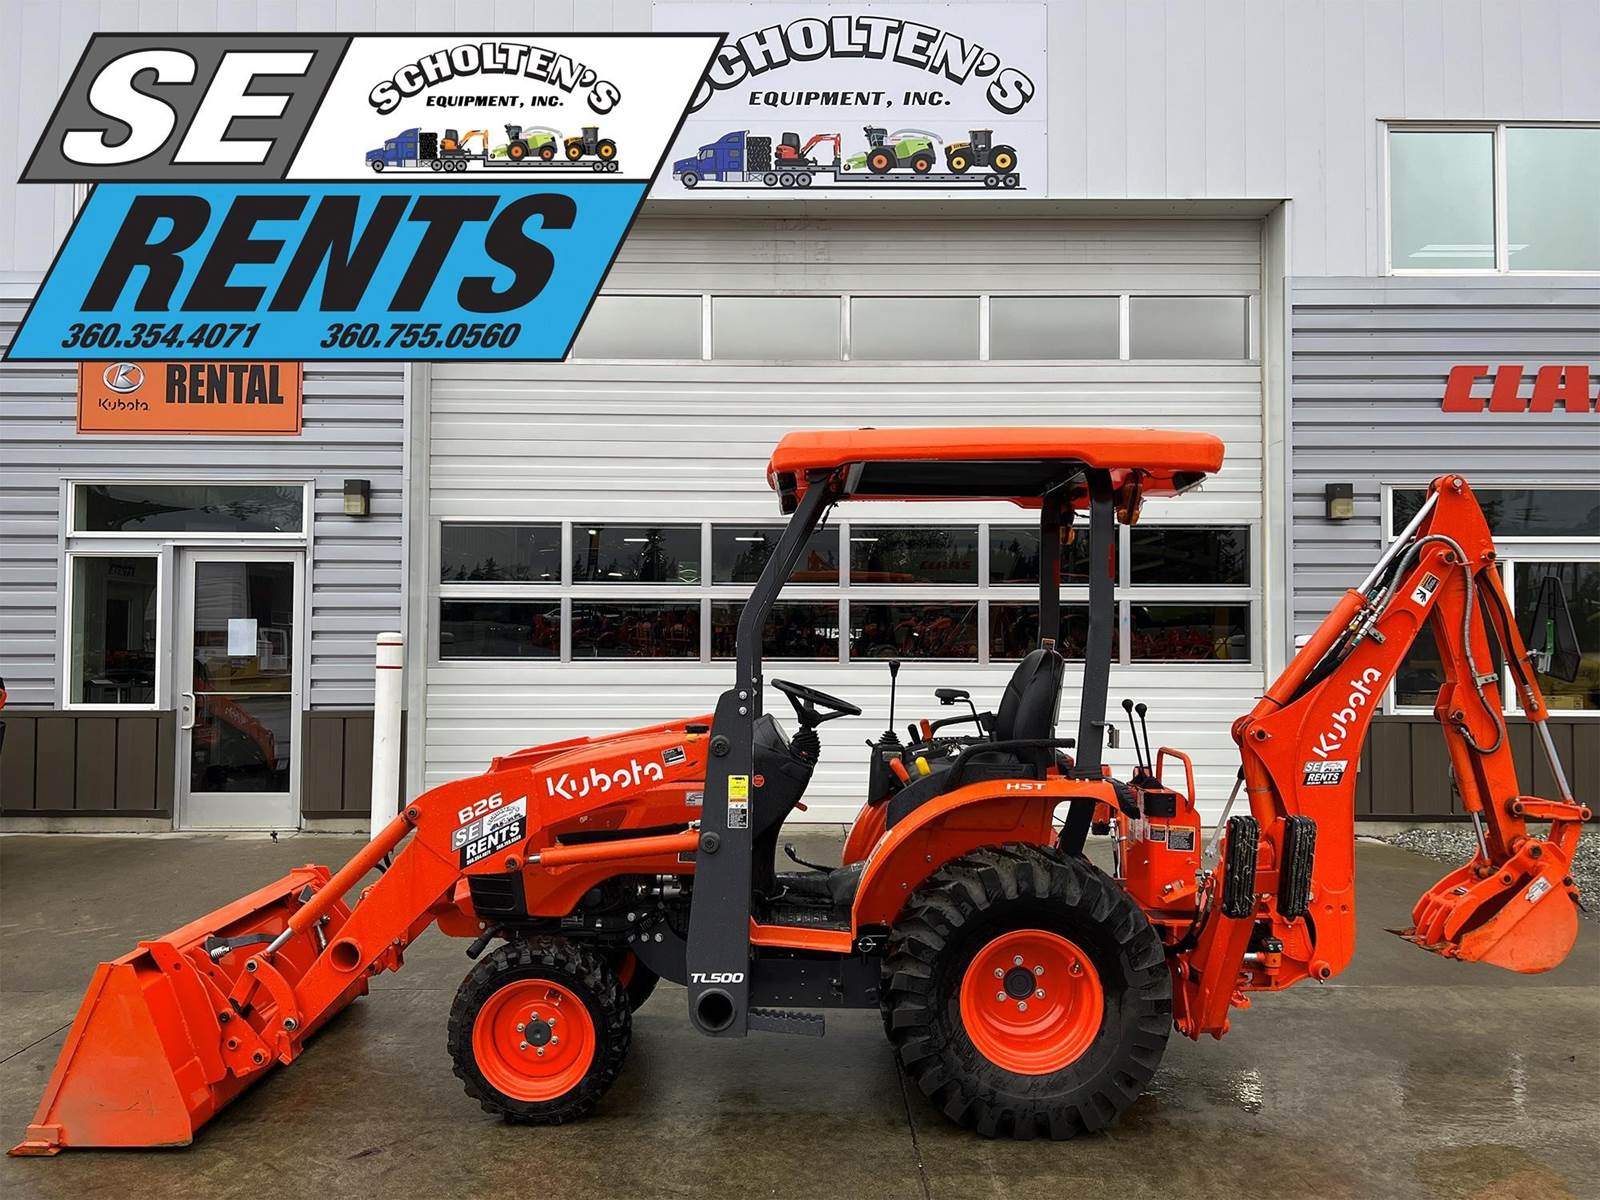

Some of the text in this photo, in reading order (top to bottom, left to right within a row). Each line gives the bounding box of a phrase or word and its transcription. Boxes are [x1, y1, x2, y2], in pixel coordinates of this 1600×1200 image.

[688, 15, 1034, 115] CHOLTEN'S
[749, 90, 951, 108] EQUIPMENT, INC.
[165, 363, 284, 405] RENTAL
[1441, 365, 1600, 413] CLA
[98, 398, 149, 411] Kubota
[1312, 667, 1382, 759] Kubota
[546, 759, 664, 800] Kubota
[1304, 762, 1321, 773] SE
[1307, 773, 1340, 782] RENTS
[1006, 783, 1047, 791] HST
[458, 792, 503, 825] B26
[455, 821, 480, 847] SE
[466, 821, 520, 860] RENTS
[690, 972, 745, 984] TL500
